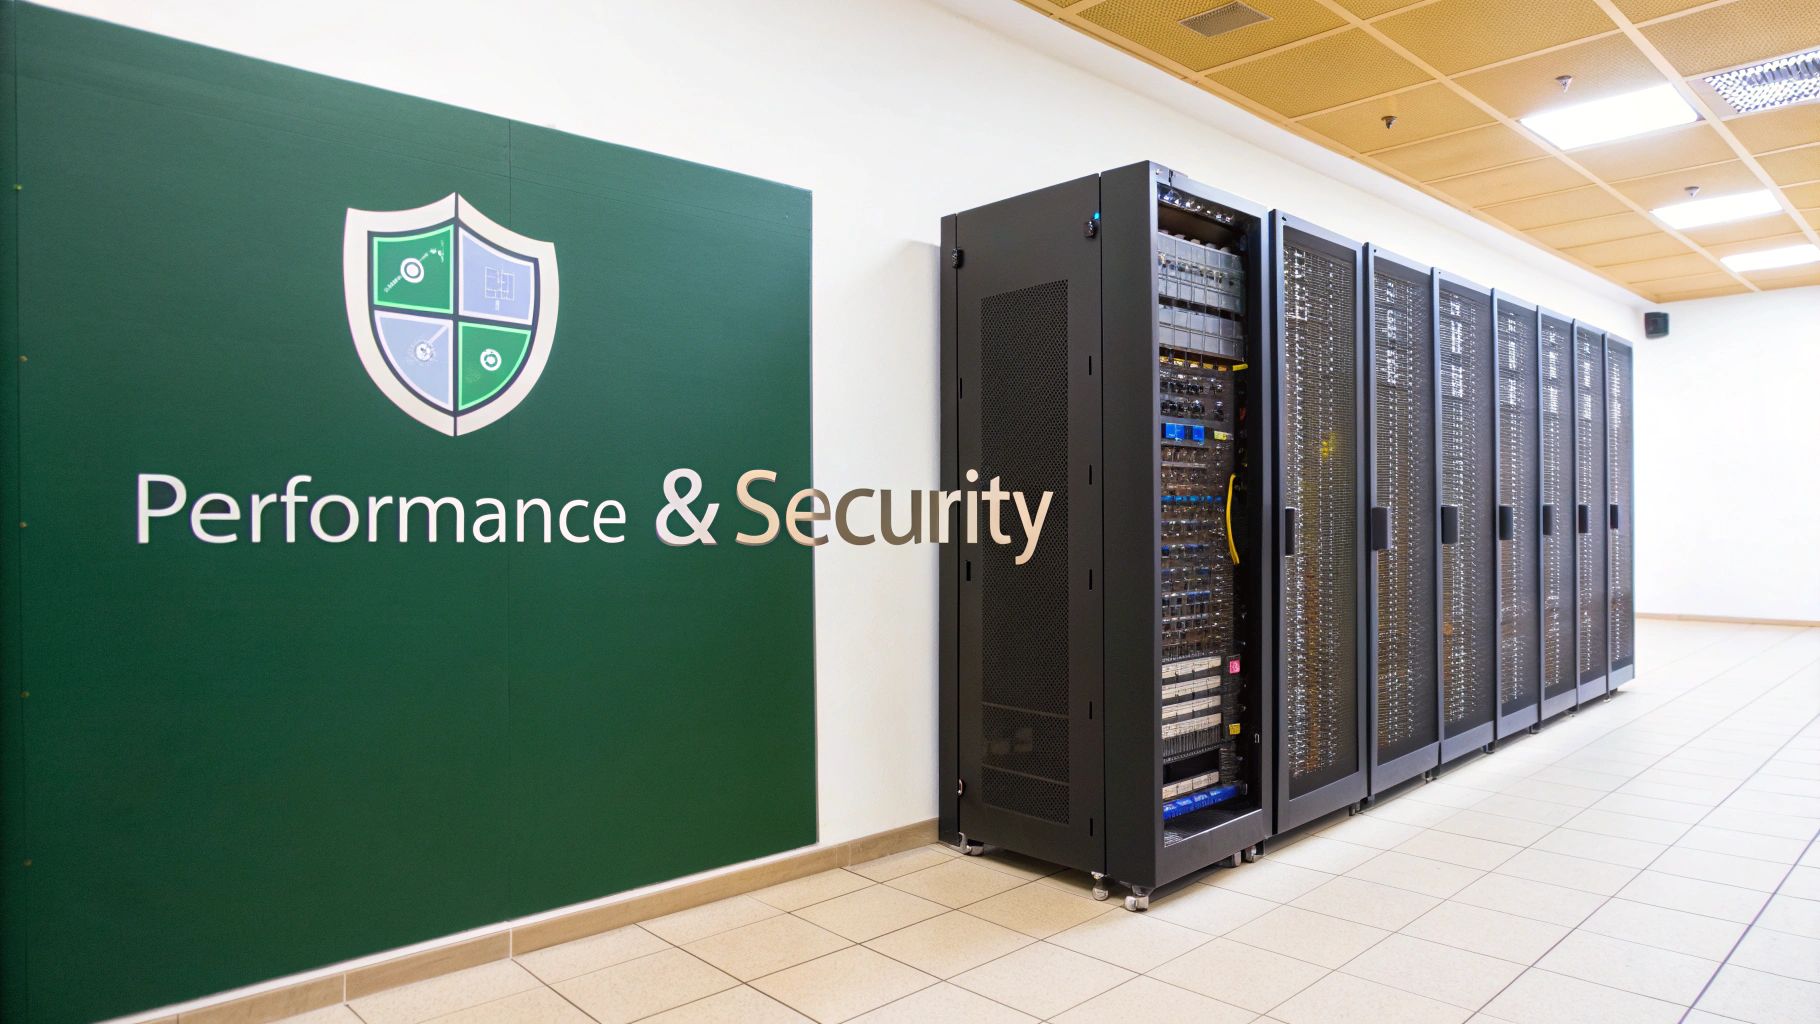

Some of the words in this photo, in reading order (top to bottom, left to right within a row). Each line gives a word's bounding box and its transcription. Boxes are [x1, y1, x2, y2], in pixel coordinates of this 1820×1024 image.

[137, 473, 627, 544] Performance
[655, 468, 720, 546] &
[735, 469, 1054, 565] Security
